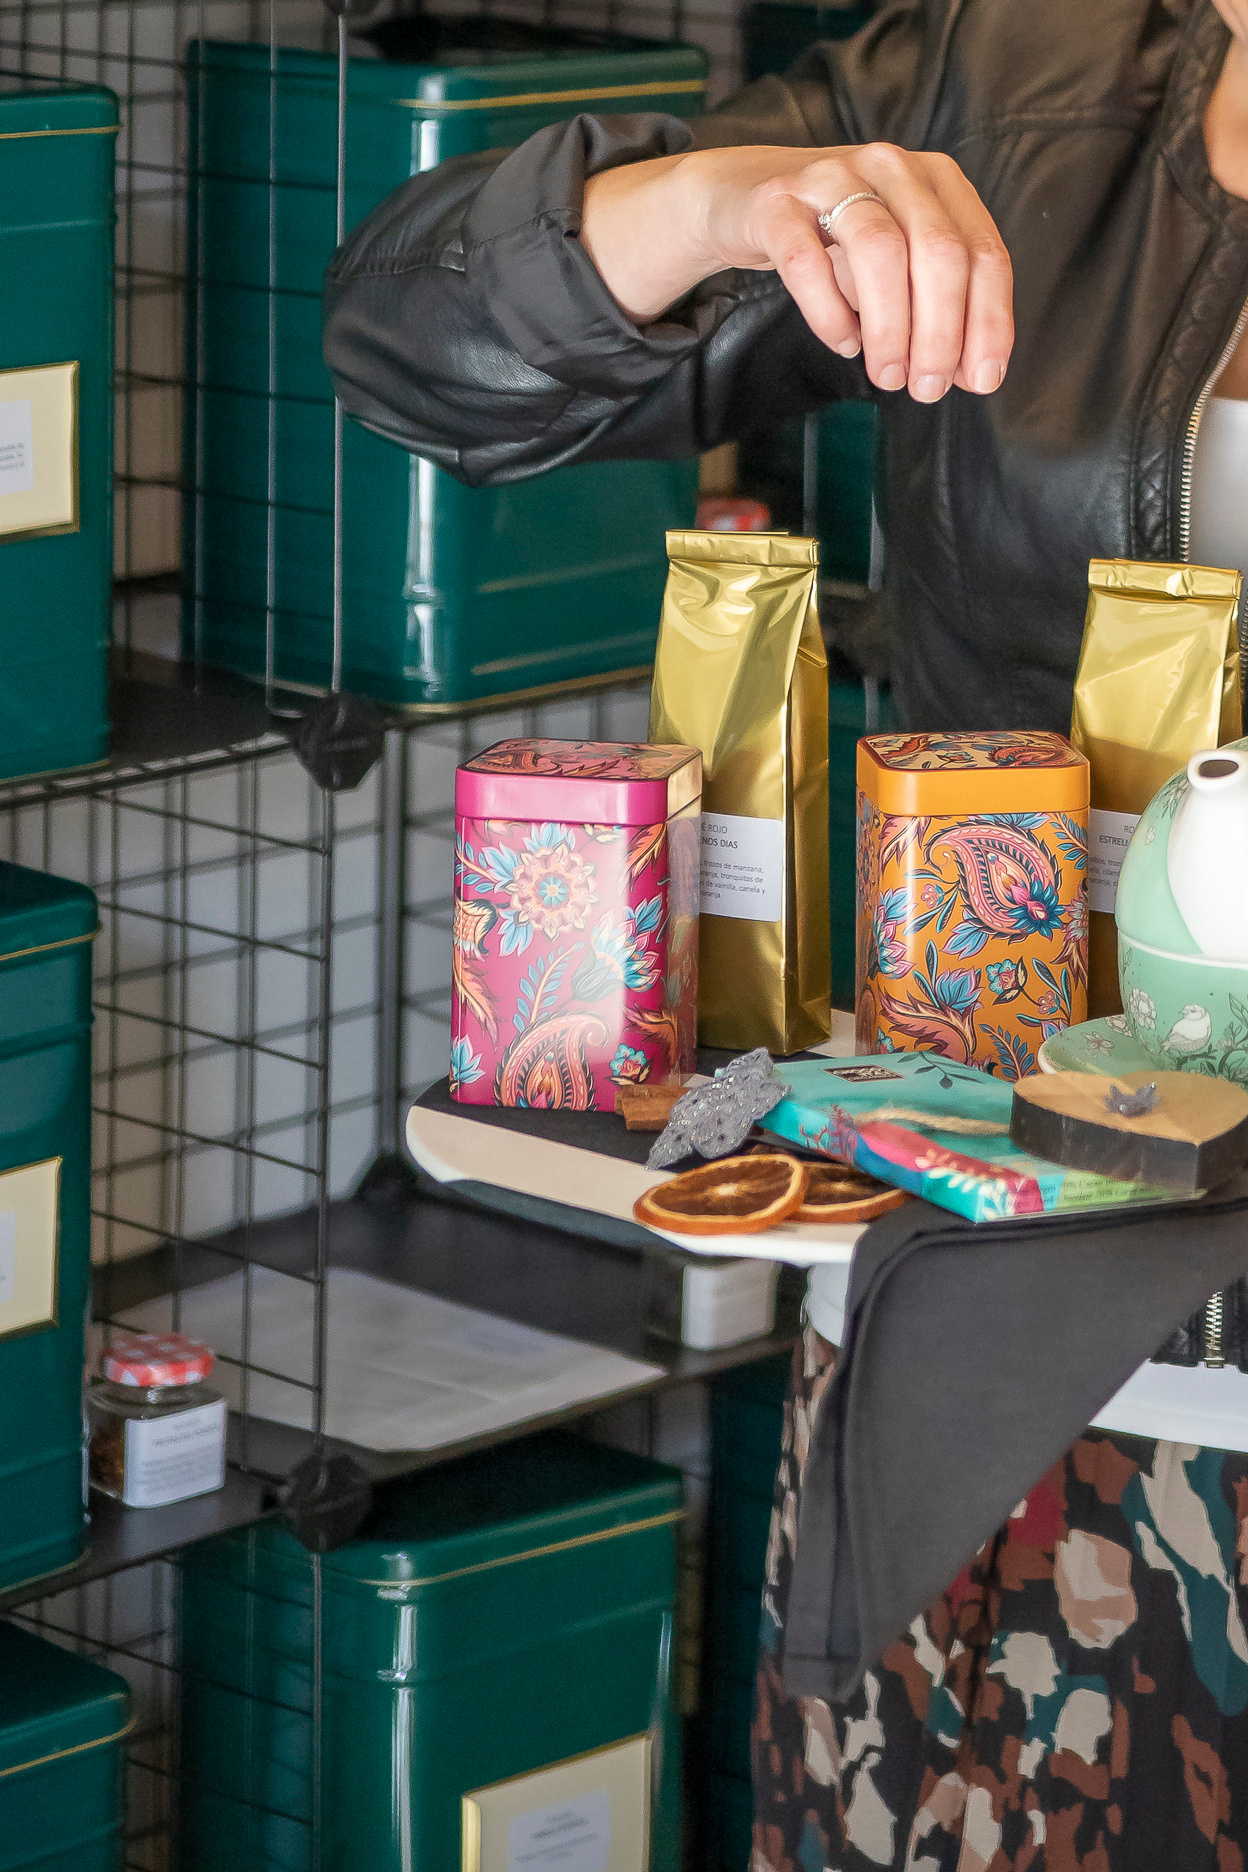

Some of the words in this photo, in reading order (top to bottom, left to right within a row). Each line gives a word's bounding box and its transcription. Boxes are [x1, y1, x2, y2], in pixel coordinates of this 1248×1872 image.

[708, 824, 727, 834] ROJO
[701, 837, 718, 846] NOS
[720, 839, 738, 848] DIAS
[1099, 835, 1128, 846] ESTRELL
[724, 862, 732, 870] de
[755, 875, 764, 884] de
